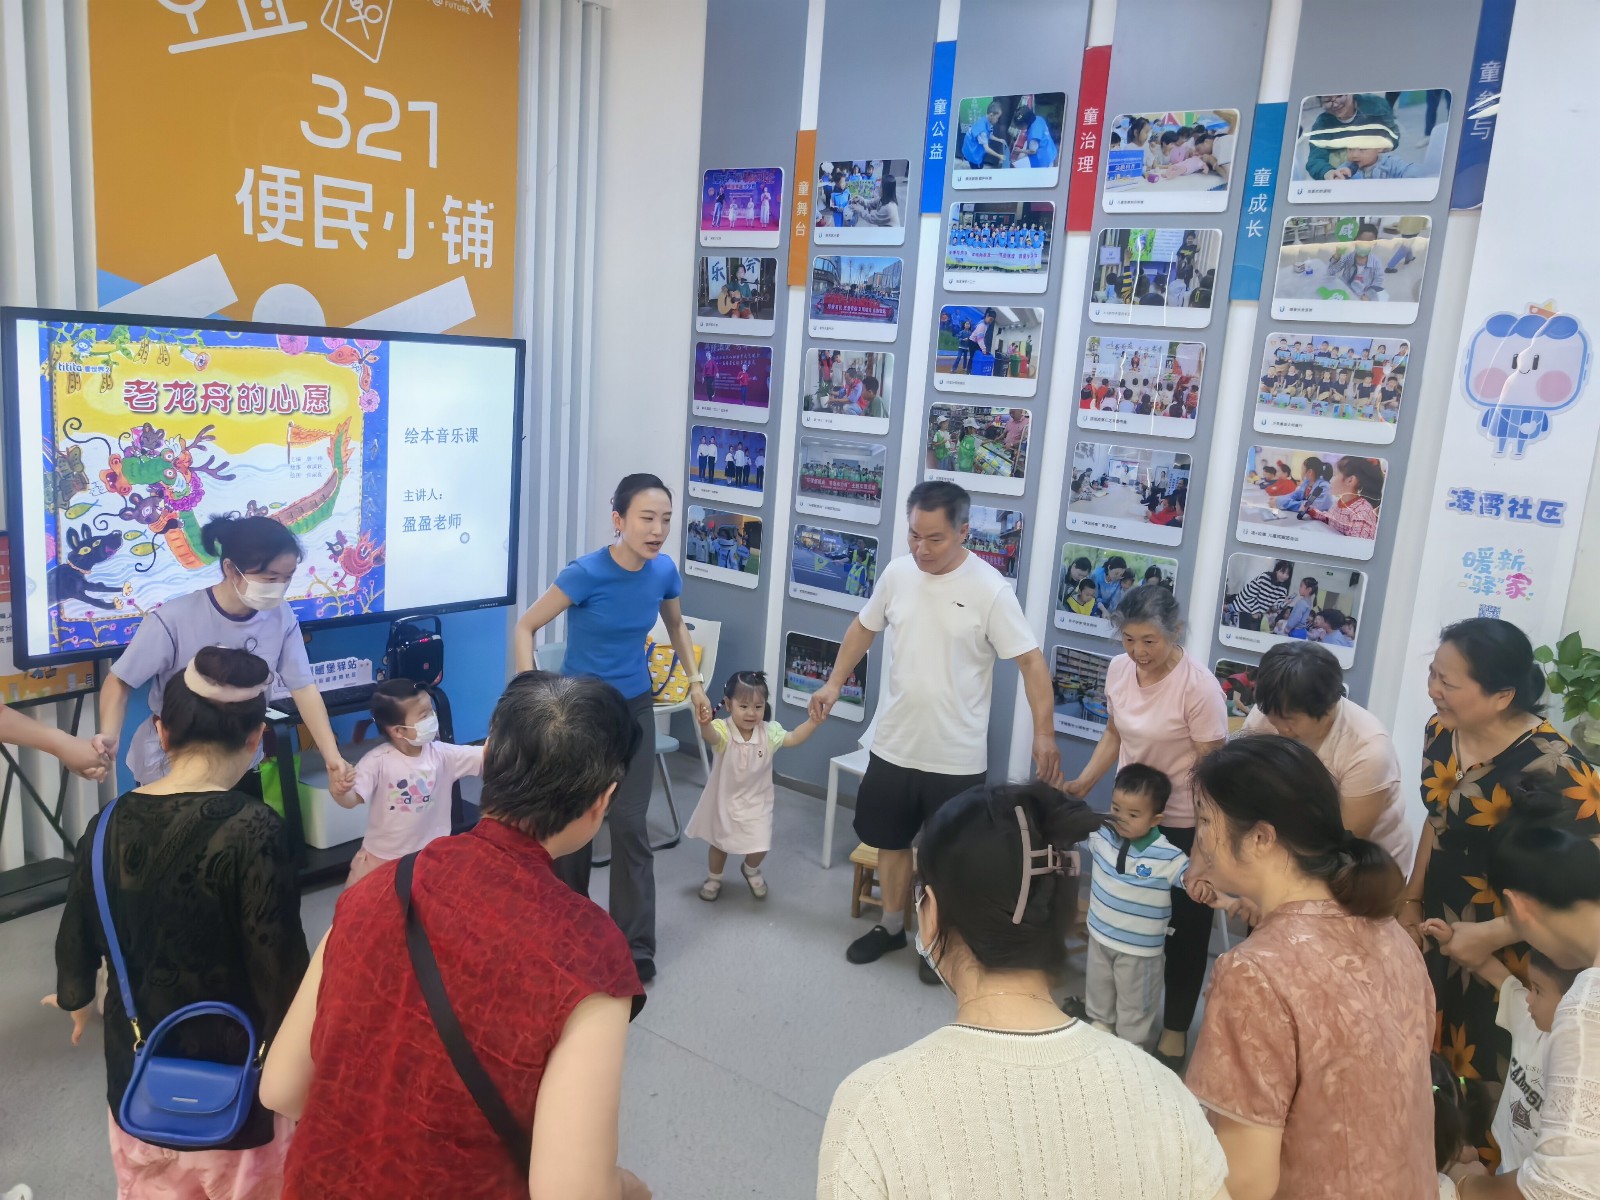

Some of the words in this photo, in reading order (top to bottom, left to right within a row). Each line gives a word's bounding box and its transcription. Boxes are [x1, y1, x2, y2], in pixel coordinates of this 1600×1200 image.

[300, 73, 438, 169] 327
[928, 98, 948, 160] 童公益
[1077, 107, 1099, 173] 童治理
[235, 164, 494, 269] 便民小铺
[795, 181, 809, 237] 童舞台
[1245, 167, 1272, 238] 童成长
[122, 378, 332, 416] 老龙舟的心愿
[404, 427, 479, 445] 绘本音乐课
[402, 513, 462, 533] 盈盈老师
[1448, 489, 1564, 524] 凌霄社区
[1462, 547, 1526, 575] 暖新
